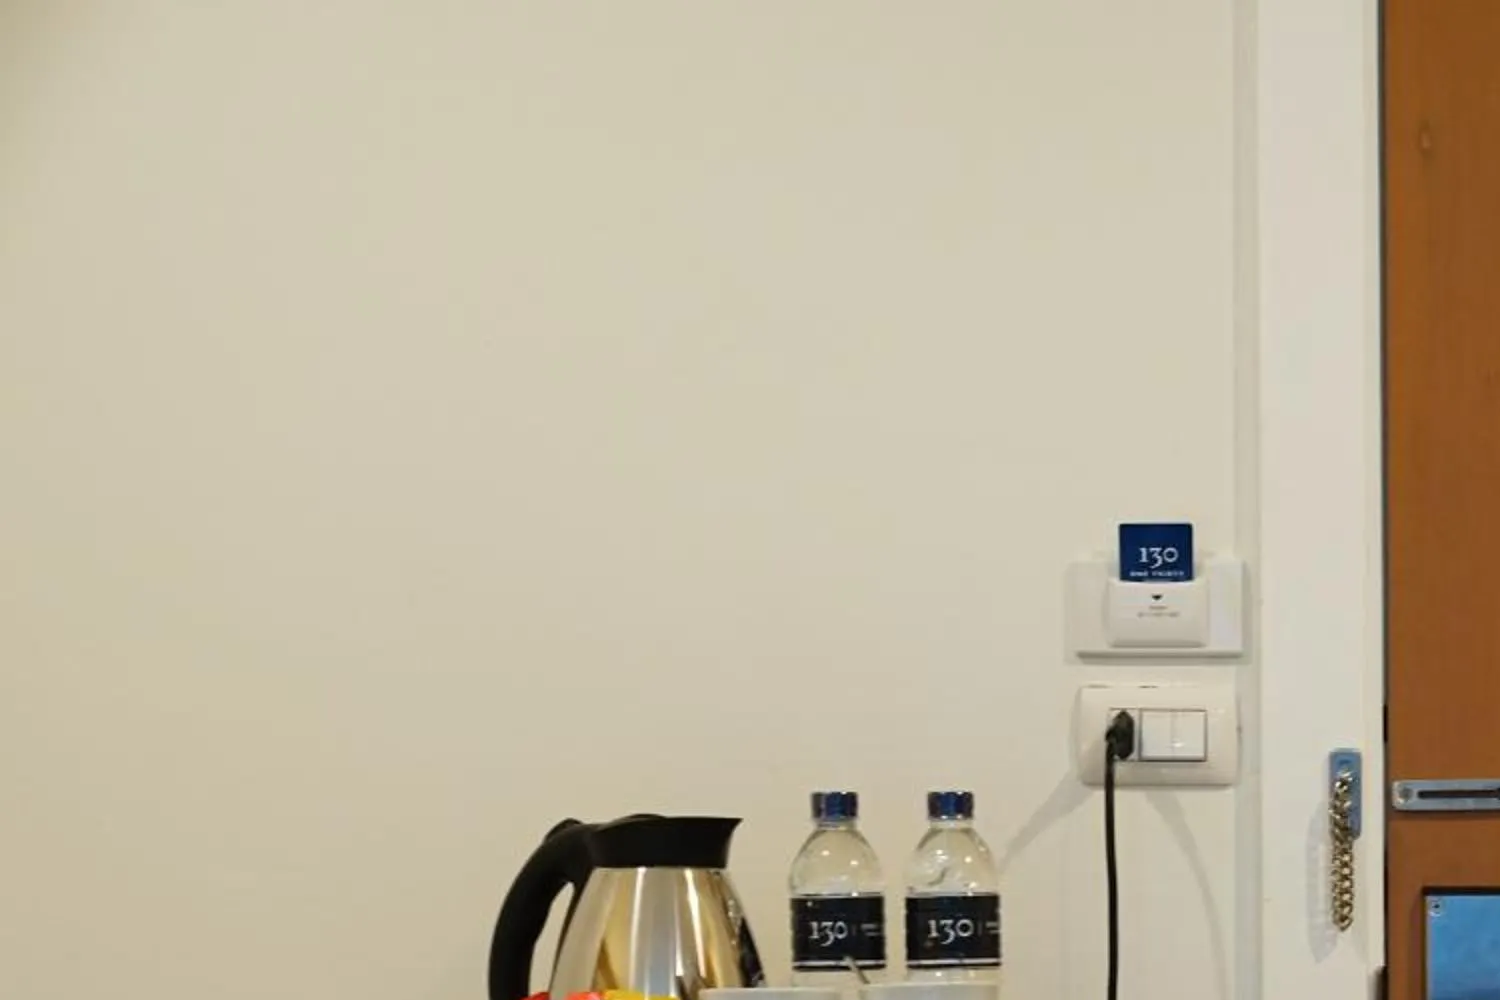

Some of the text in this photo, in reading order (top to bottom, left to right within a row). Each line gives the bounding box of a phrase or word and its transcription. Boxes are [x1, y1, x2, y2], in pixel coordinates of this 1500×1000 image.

[1138, 547, 1180, 569] 130
[808, 920, 849, 947] 130
[927, 918, 975, 945] 130
